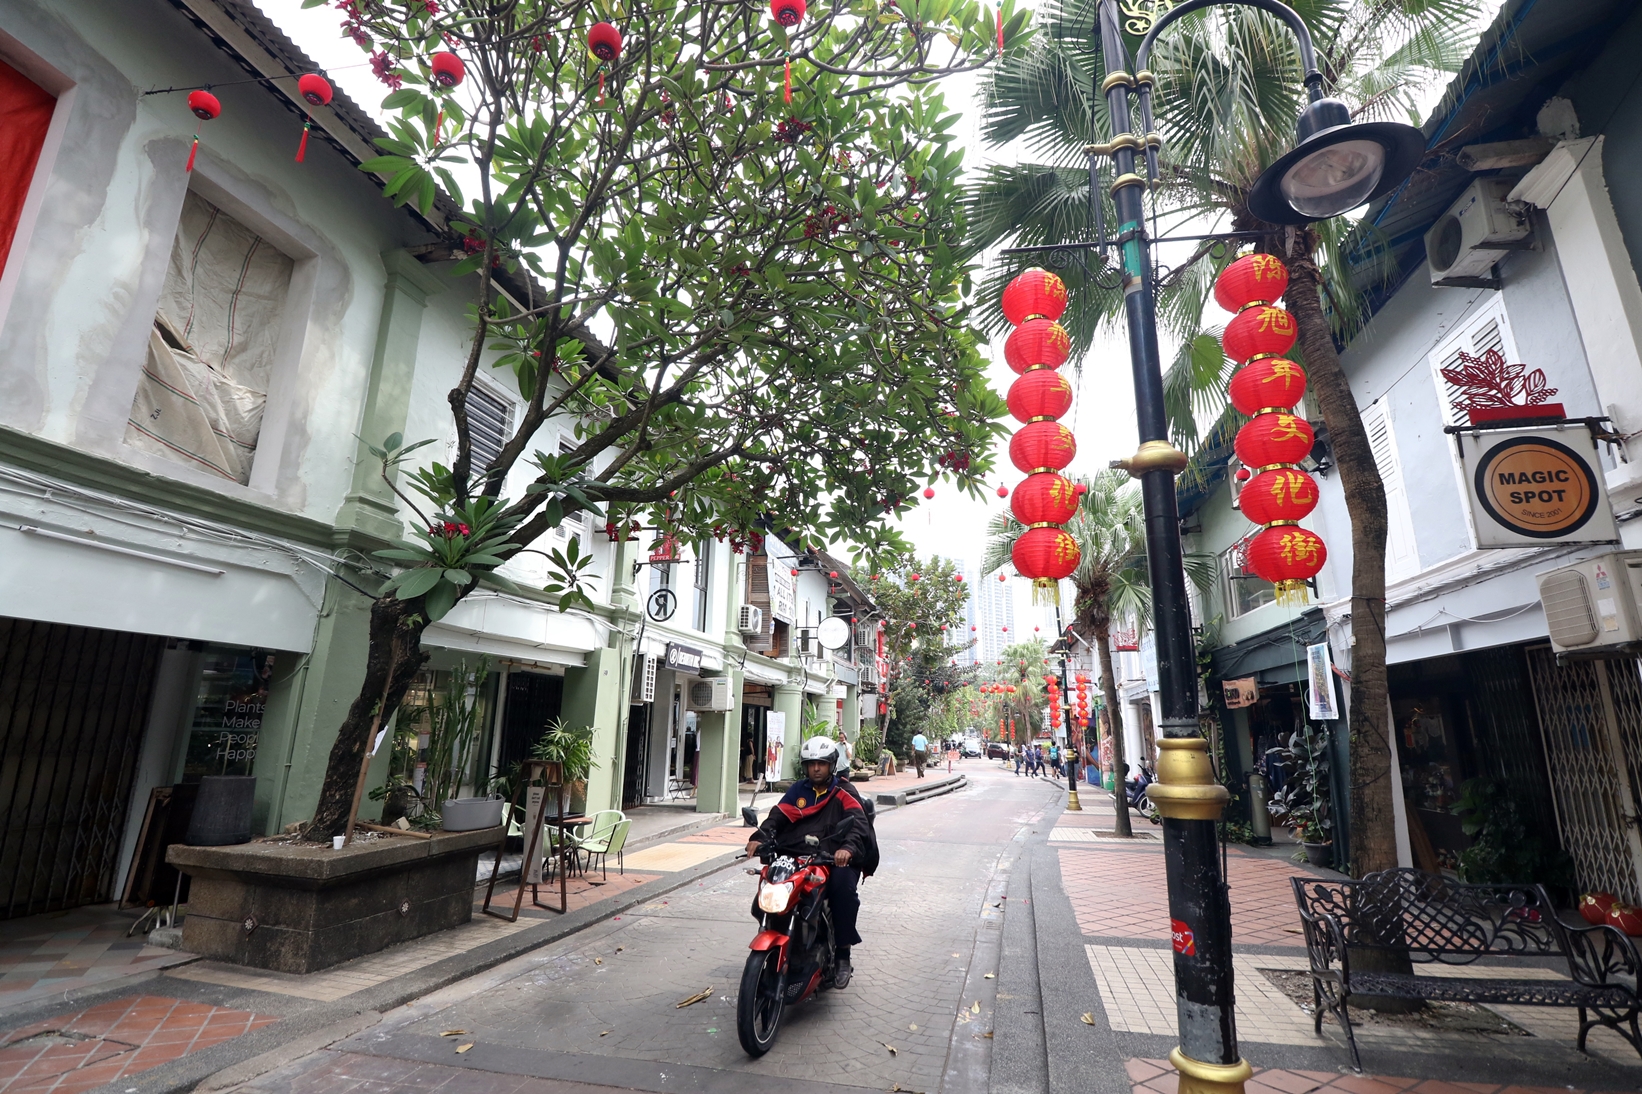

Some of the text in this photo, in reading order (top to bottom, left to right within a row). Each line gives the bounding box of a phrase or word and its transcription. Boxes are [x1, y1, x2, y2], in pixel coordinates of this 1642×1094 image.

[1498, 469, 1570, 486] MAGIC
[1510, 489, 1566, 504] SPOT
[1521, 508, 1545, 519] SINCE
[225, 700, 266, 714] Plants
[222, 716, 261, 728] Make
[219, 732, 259, 748] Peopl
[216, 748, 257, 762] Happ
[1171, 931, 1184, 943] ost
